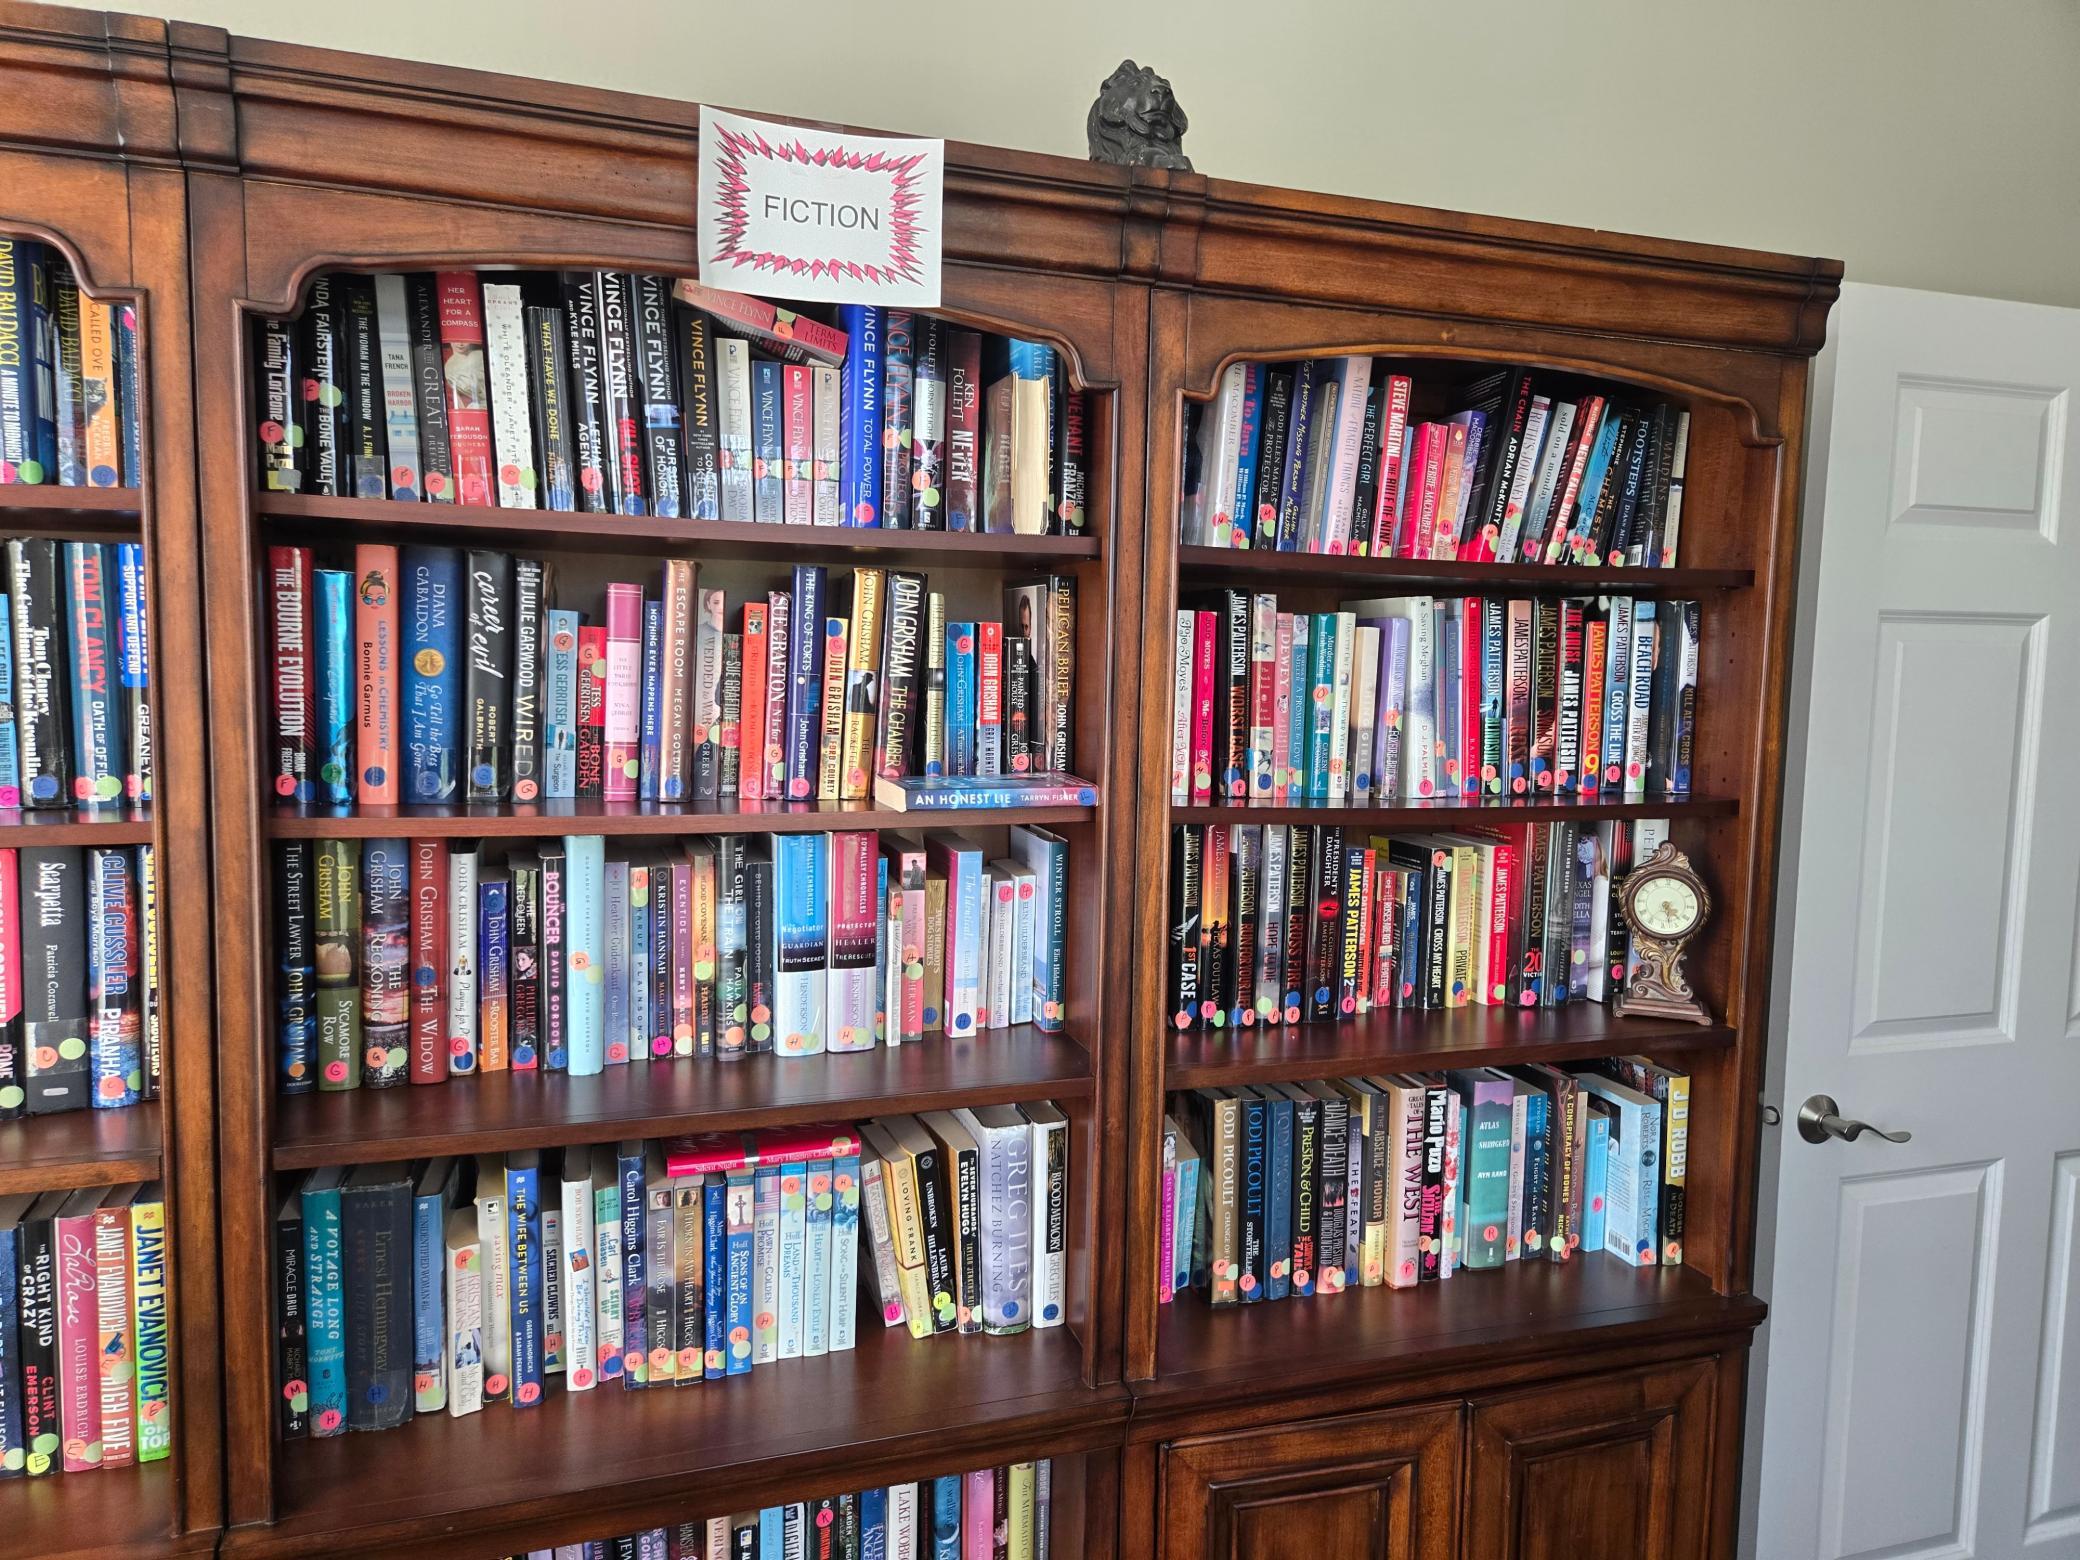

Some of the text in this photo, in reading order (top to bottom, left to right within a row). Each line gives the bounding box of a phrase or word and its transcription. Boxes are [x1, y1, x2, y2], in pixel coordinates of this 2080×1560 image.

[765, 194, 879, 230] FICTION
[0, 241, 19, 367] DAVID BALDACCI
[418, 285, 433, 352] ALEXANDER
[60, 290, 82, 402] DAVID BALDACCI
[578, 283, 599, 404] VINCE FLYNN
[691, 320, 705, 370] VINCE
[423, 367, 443, 428] GREAT
[694, 373, 708, 427] FLYNN
[1387, 380, 1407, 458] STEVE MARTINI
[91, 414, 101, 460] BACKMAN
[1262, 434, 1274, 494] PROTECTOR
[1360, 404, 1375, 484] THE PERFECT GIRL
[1626, 420, 1649, 497] FOOTSTEPS
[1591, 466, 1612, 533] CHEMIST
[1657, 443, 1673, 502] MAIDENS
[73, 555, 106, 694] TOM CLANCY
[416, 567, 429, 643] GABALDON
[432, 583, 446, 628] DIANA
[472, 570, 504, 634] career
[521, 589, 536, 623] JULIE
[276, 567, 305, 737] THE BOURNE EVOLUTION
[519, 625, 535, 688] GARWOOD
[673, 587, 687, 776] ESCAPE ROOM MEGAN GOLDIN
[886, 575, 920, 768] JOHN GRISHAM THE CHAMBER
[1056, 588, 1070, 772] PELICAN BRIEF JOHN GRISHAM
[1279, 633, 1290, 690] DEWEY
[1488, 603, 1502, 695] JAMES PATTERSON
[363, 641, 373, 728] Bonnie Garmus
[556, 678, 568, 726] GERRITSEN
[982, 652, 999, 721] JOHN GRISHAM
[1588, 623, 1605, 754] JAMES PATTERSON
[476, 698, 485, 750] GALBRAITH
[487, 706, 496, 743] ROBERT
[515, 694, 536, 776] WIRED
[1560, 670, 1580, 770] JAMES PATTERSON
[701, 742, 710, 777] GREEN
[915, 794, 934, 805] AN
[939, 793, 990, 805] HONEST
[994, 793, 1011, 804] LIE
[1020, 794, 1050, 802] TARRYN
[32, 862, 66, 928] Scarpetta
[318, 855, 335, 920] GRISHAM
[337, 864, 354, 903] JOHN
[370, 851, 386, 915] GRISHAM
[388, 863, 402, 900] JOHN
[734, 846, 744, 903] THE GIRL
[1054, 854, 1064, 936] WINTER STROLL
[1184, 832, 1200, 908] JAMES PATTERSON
[1324, 836, 1334, 887] DAUGHTER
[102, 856, 128, 996] CLIVE CUSSLER
[286, 845, 304, 960] THE STREET LAWYER
[458, 860, 468, 952] JOHN GRISHAM
[546, 871, 560, 944] BOUNCER
[1343, 868, 1362, 977] JAMES PATTERSON
[1493, 866, 1508, 934] JAMES PATTERSON
[46, 944, 59, 1023] Patricia Cornwell
[370, 932, 386, 1021] RECKONING
[418, 843, 438, 1076] JOHN GRISHAM THE WIDOW
[323, 1016, 337, 1046] ROW
[337, 1000, 353, 1059] SYCAMORE
[551, 951, 560, 1046] DAVID GORDON
[726, 977, 734, 1026] HAWKINS
[800, 975, 809, 1032] HENDERSON
[98, 1007, 122, 1079] PIRANHA
[1222, 1105, 1237, 1208] JODI PICOULT
[1479, 1139, 1510, 1148] SHRUGGED
[1480, 1121, 1500, 1129] ATLAS
[1562, 1101, 1575, 1204] CONSPIRACY OF BONES
[1642, 1112, 1650, 1151] ROBERTS
[1649, 1116, 1661, 1145] NORA
[1247, 1106, 1263, 1217] JODI PICOULT
[1403, 1115, 1423, 1224] THE WEST
[623, 1170, 642, 1286] Carol Higgins Clark
[901, 1181, 917, 1262] LOVING FRANK
[925, 1181, 938, 1229] UNBROKEN
[960, 1161, 970, 1236] EVELYN HUGO
[990, 1139, 1003, 1293] NATCHEZ BURNING
[1007, 1138, 1028, 1292] GREG ILES
[1641, 1207, 1652, 1240] MAGIC
[1669, 1203, 1677, 1236] DEATH
[783, 1242, 793, 1278] DREAMS
[939, 1248, 948, 1279] LAURA
[1252, 1238, 1260, 1256] THE
[1486, 1228, 1496, 1239] R
[309, 1227, 324, 1329] AND STRANGE
[375, 1230, 393, 1371] Ernest Hemingway
[545, 1249, 560, 1320] SACRED CLOWNS
[729, 1252, 741, 1323] ANCIENT GLORY
[791, 1274, 801, 1324] THOUSAND
[136, 1224, 168, 1407] JANET EVANOVICH
[25, 1365, 40, 1436] EMERSON
[42, 1376, 55, 1420] CLINT
